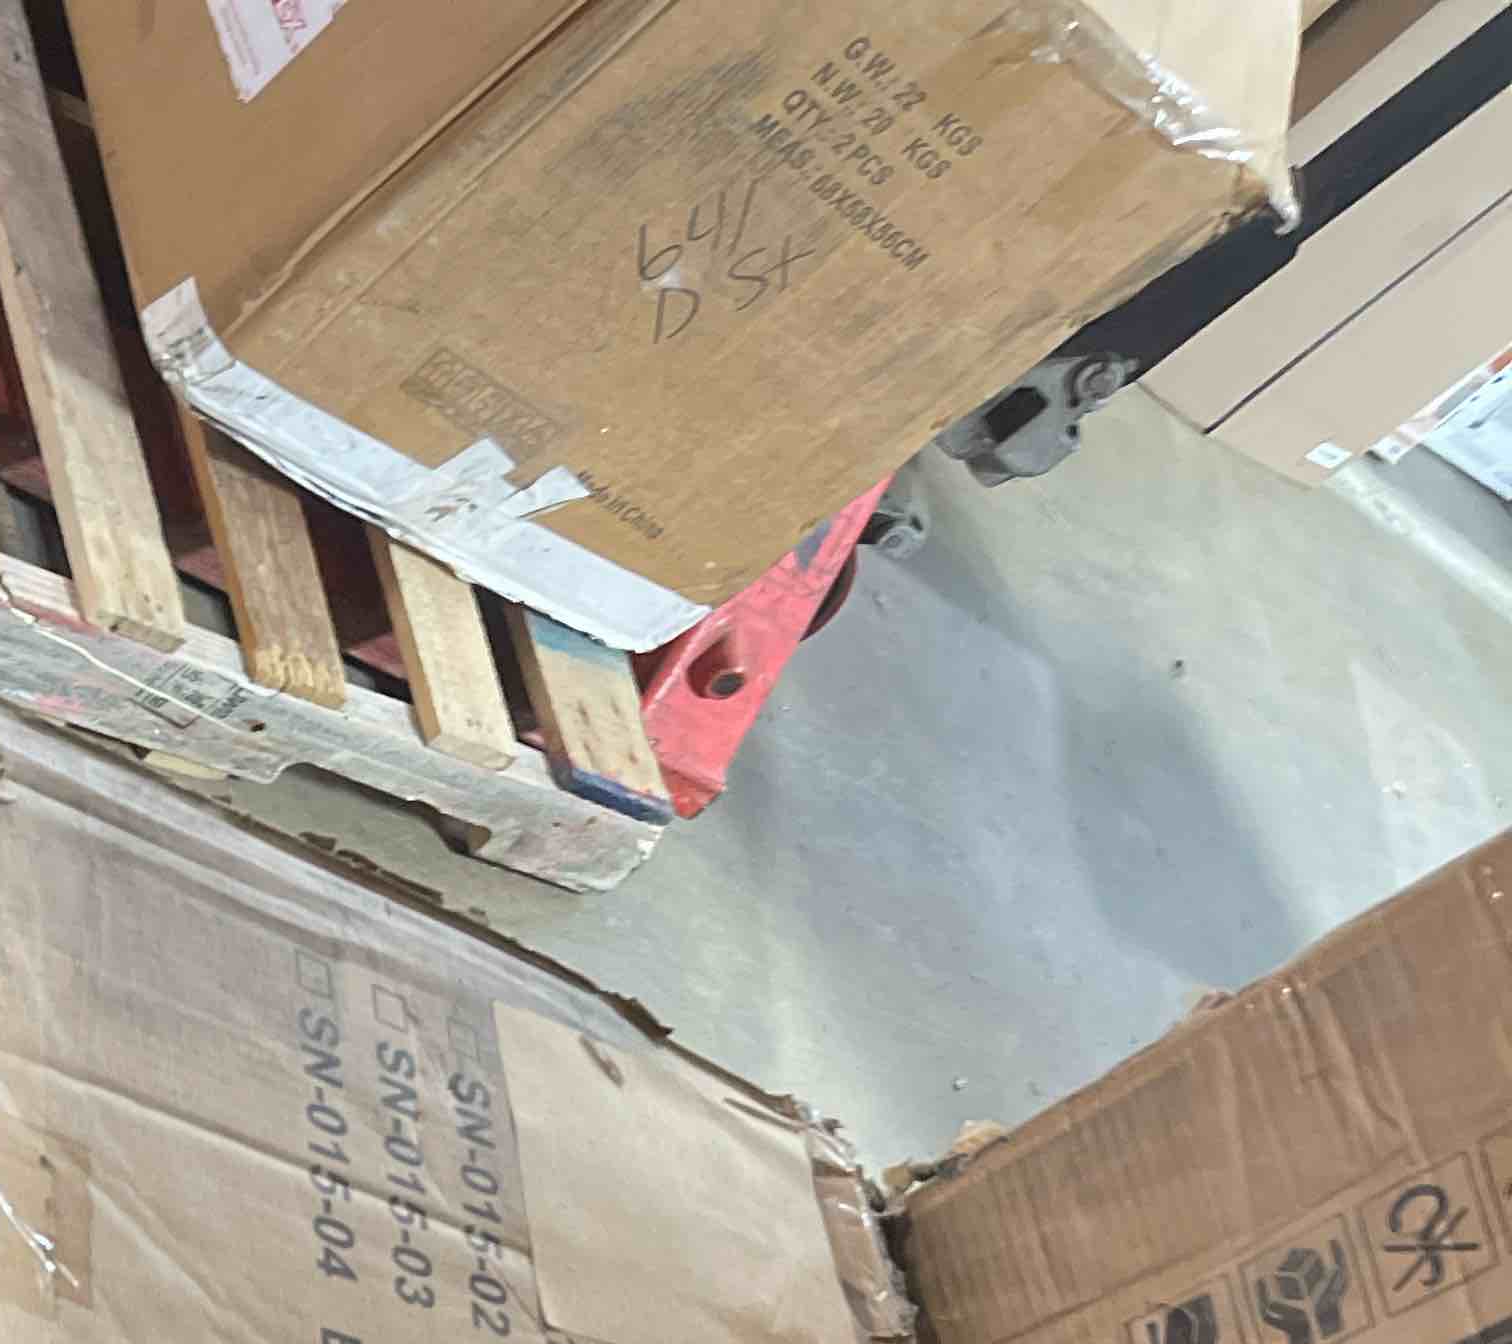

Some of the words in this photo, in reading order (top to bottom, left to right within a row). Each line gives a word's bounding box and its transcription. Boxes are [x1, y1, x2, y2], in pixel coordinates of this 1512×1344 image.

[861, 106, 896, 137] 20
[899, 136, 953, 180] KGS
[892, 80, 928, 112] 22
[931, 111, 985, 157] KGS
[298, 1007, 359, 1283] SN-015-04
[375, 1041, 437, 1312] SN-015-03
[447, 1072, 511, 1339] SN-015-02
